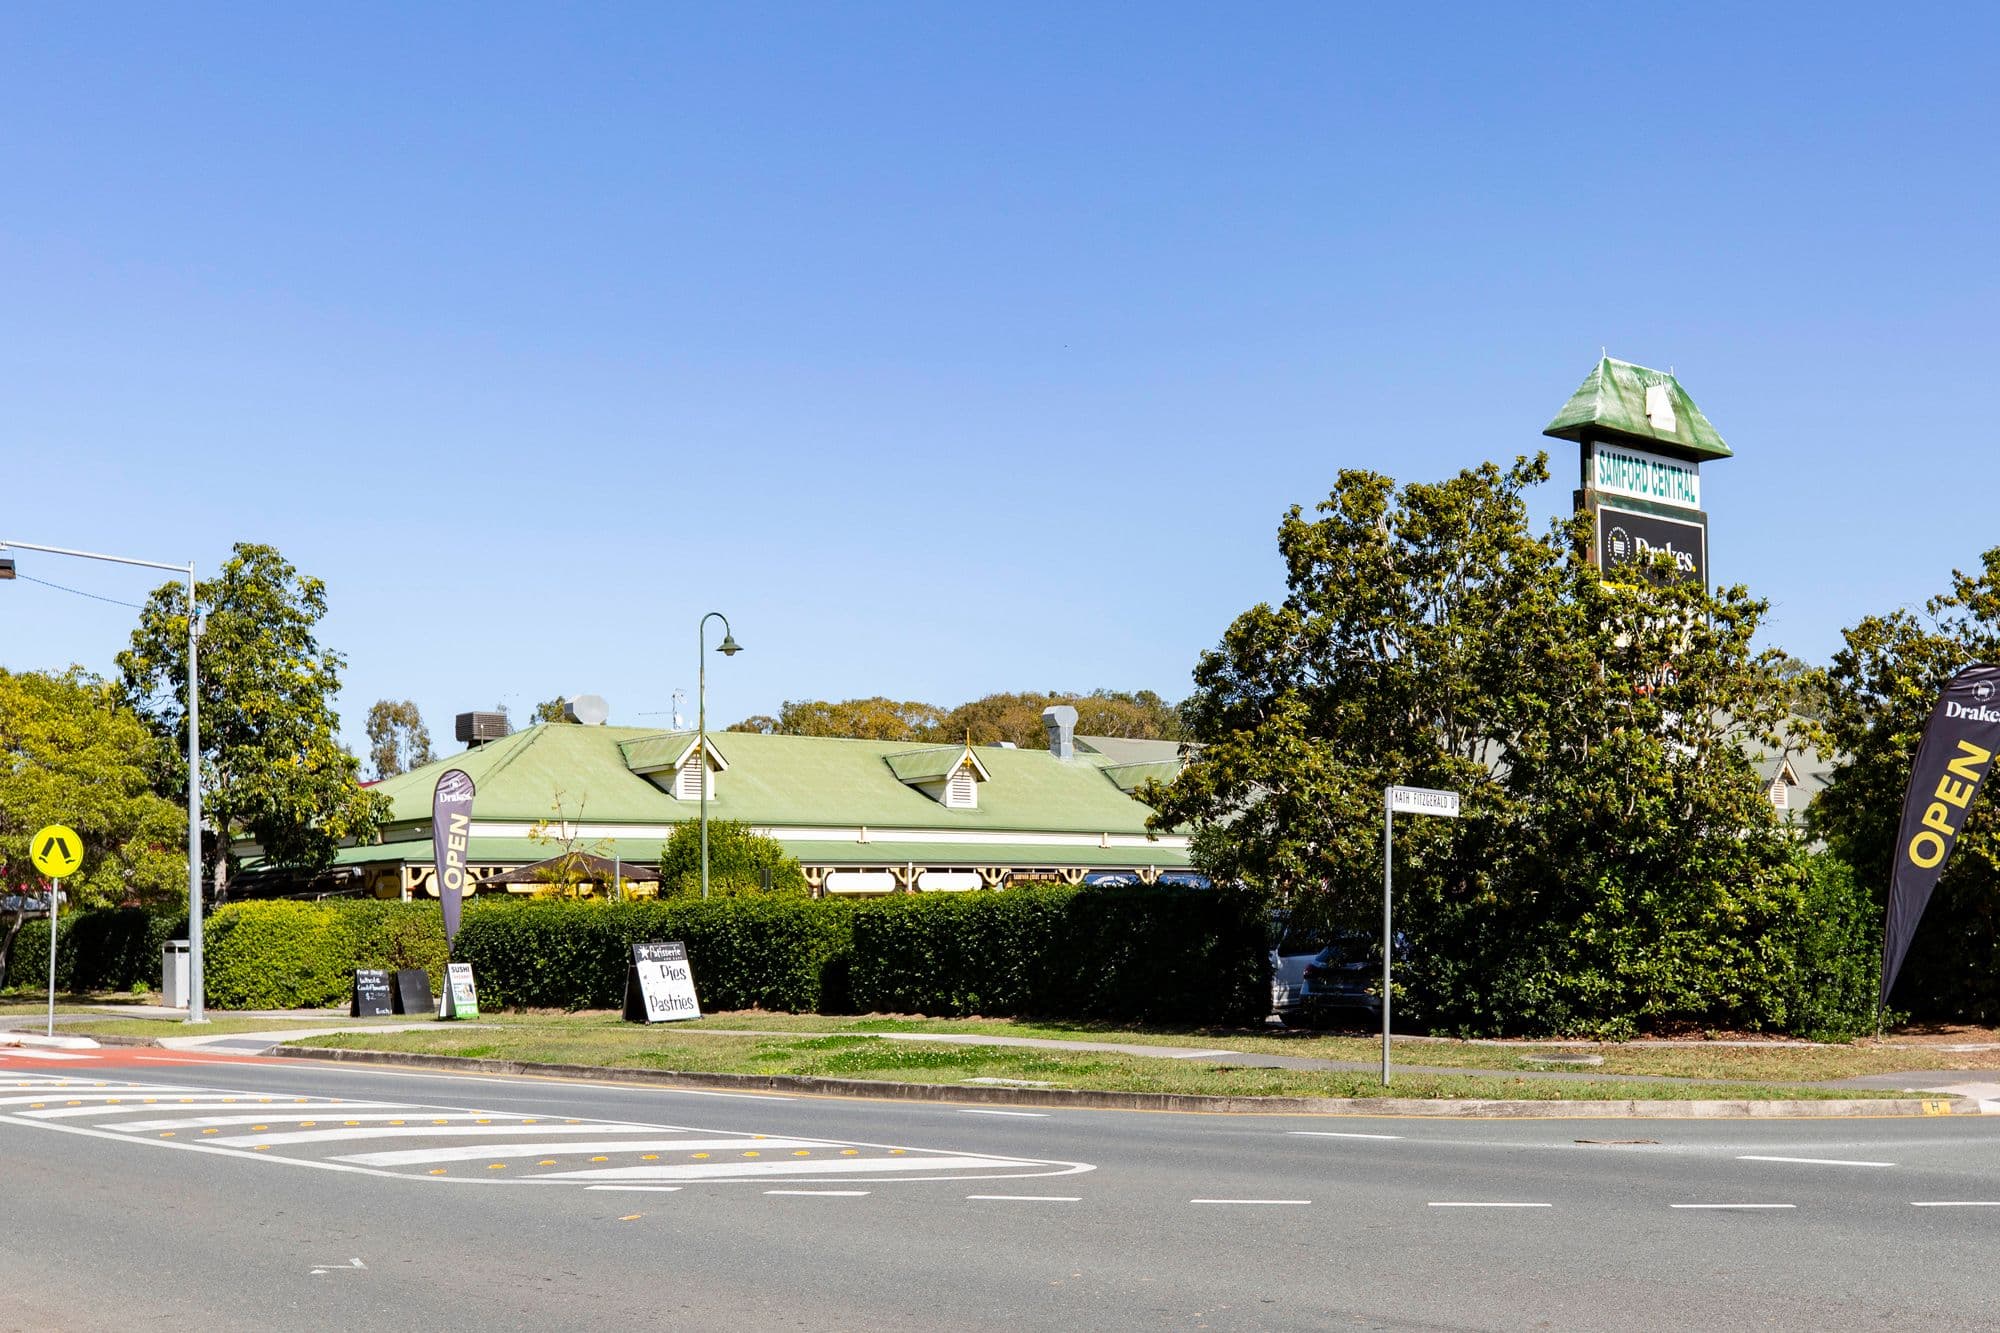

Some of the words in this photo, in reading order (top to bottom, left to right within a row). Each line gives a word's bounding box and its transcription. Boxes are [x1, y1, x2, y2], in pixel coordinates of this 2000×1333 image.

[1600, 450, 1648, 493] SAMFORD
[1651, 461, 1695, 503] CENTRAL
[1634, 536, 1697, 573] Drkes.
[1945, 701, 2000, 723] Drake
[1395, 791, 1410, 804] KATH
[1413, 792, 1448, 809] FITZGERALD
[1908, 739, 1991, 869] OPEN
[443, 813, 469, 890] OPEN
[660, 964, 687, 981] Pies
[649, 993, 694, 1013] Pastries
